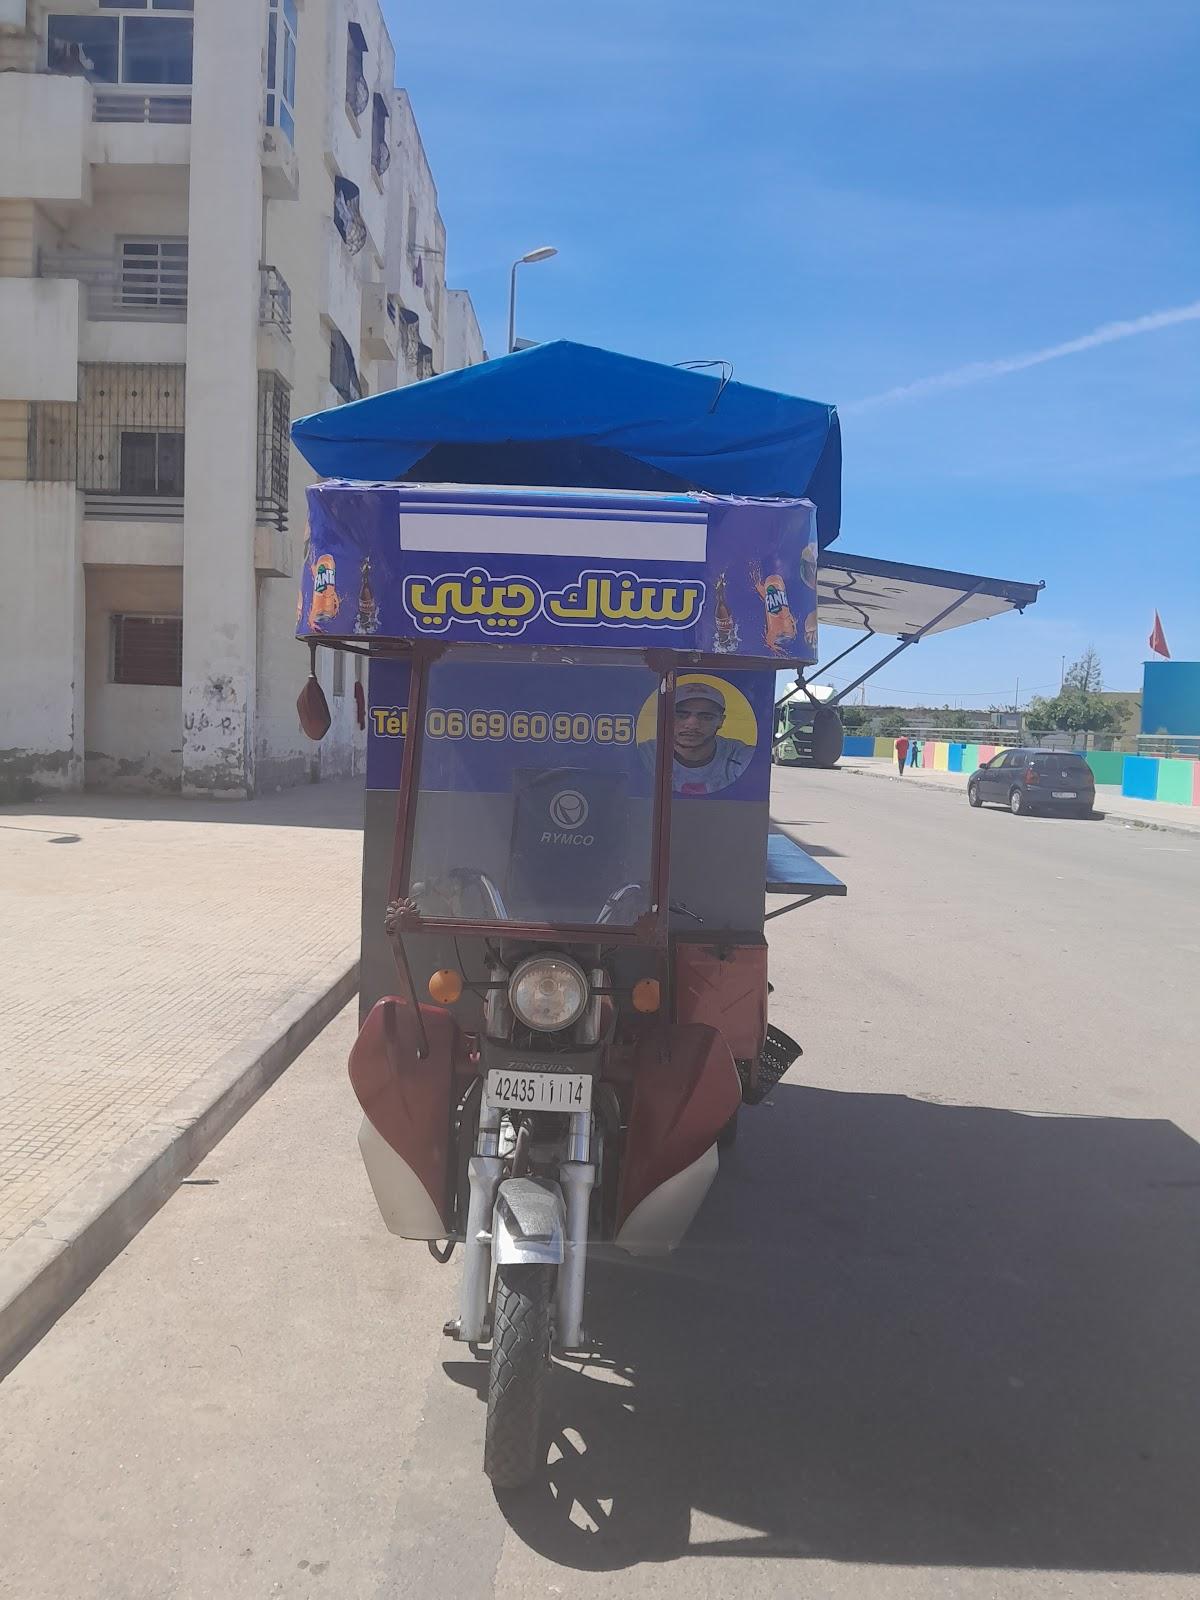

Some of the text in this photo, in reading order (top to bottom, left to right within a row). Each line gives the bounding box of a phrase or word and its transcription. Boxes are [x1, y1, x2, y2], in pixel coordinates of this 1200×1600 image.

[411, 576, 698, 627] سناك جيني
[428, 712, 463, 737] 06
[470, 714, 506, 739] 69
[512, 715, 548, 739] 60
[555, 716, 590, 740] 90
[596, 716, 632, 742] 65
[540, 831, 595, 847] RYMCO
[506, 1061, 576, 1073] ZONGSHEN
[495, 1077, 535, 1102] 42435
[568, 1081, 584, 1105] 14
